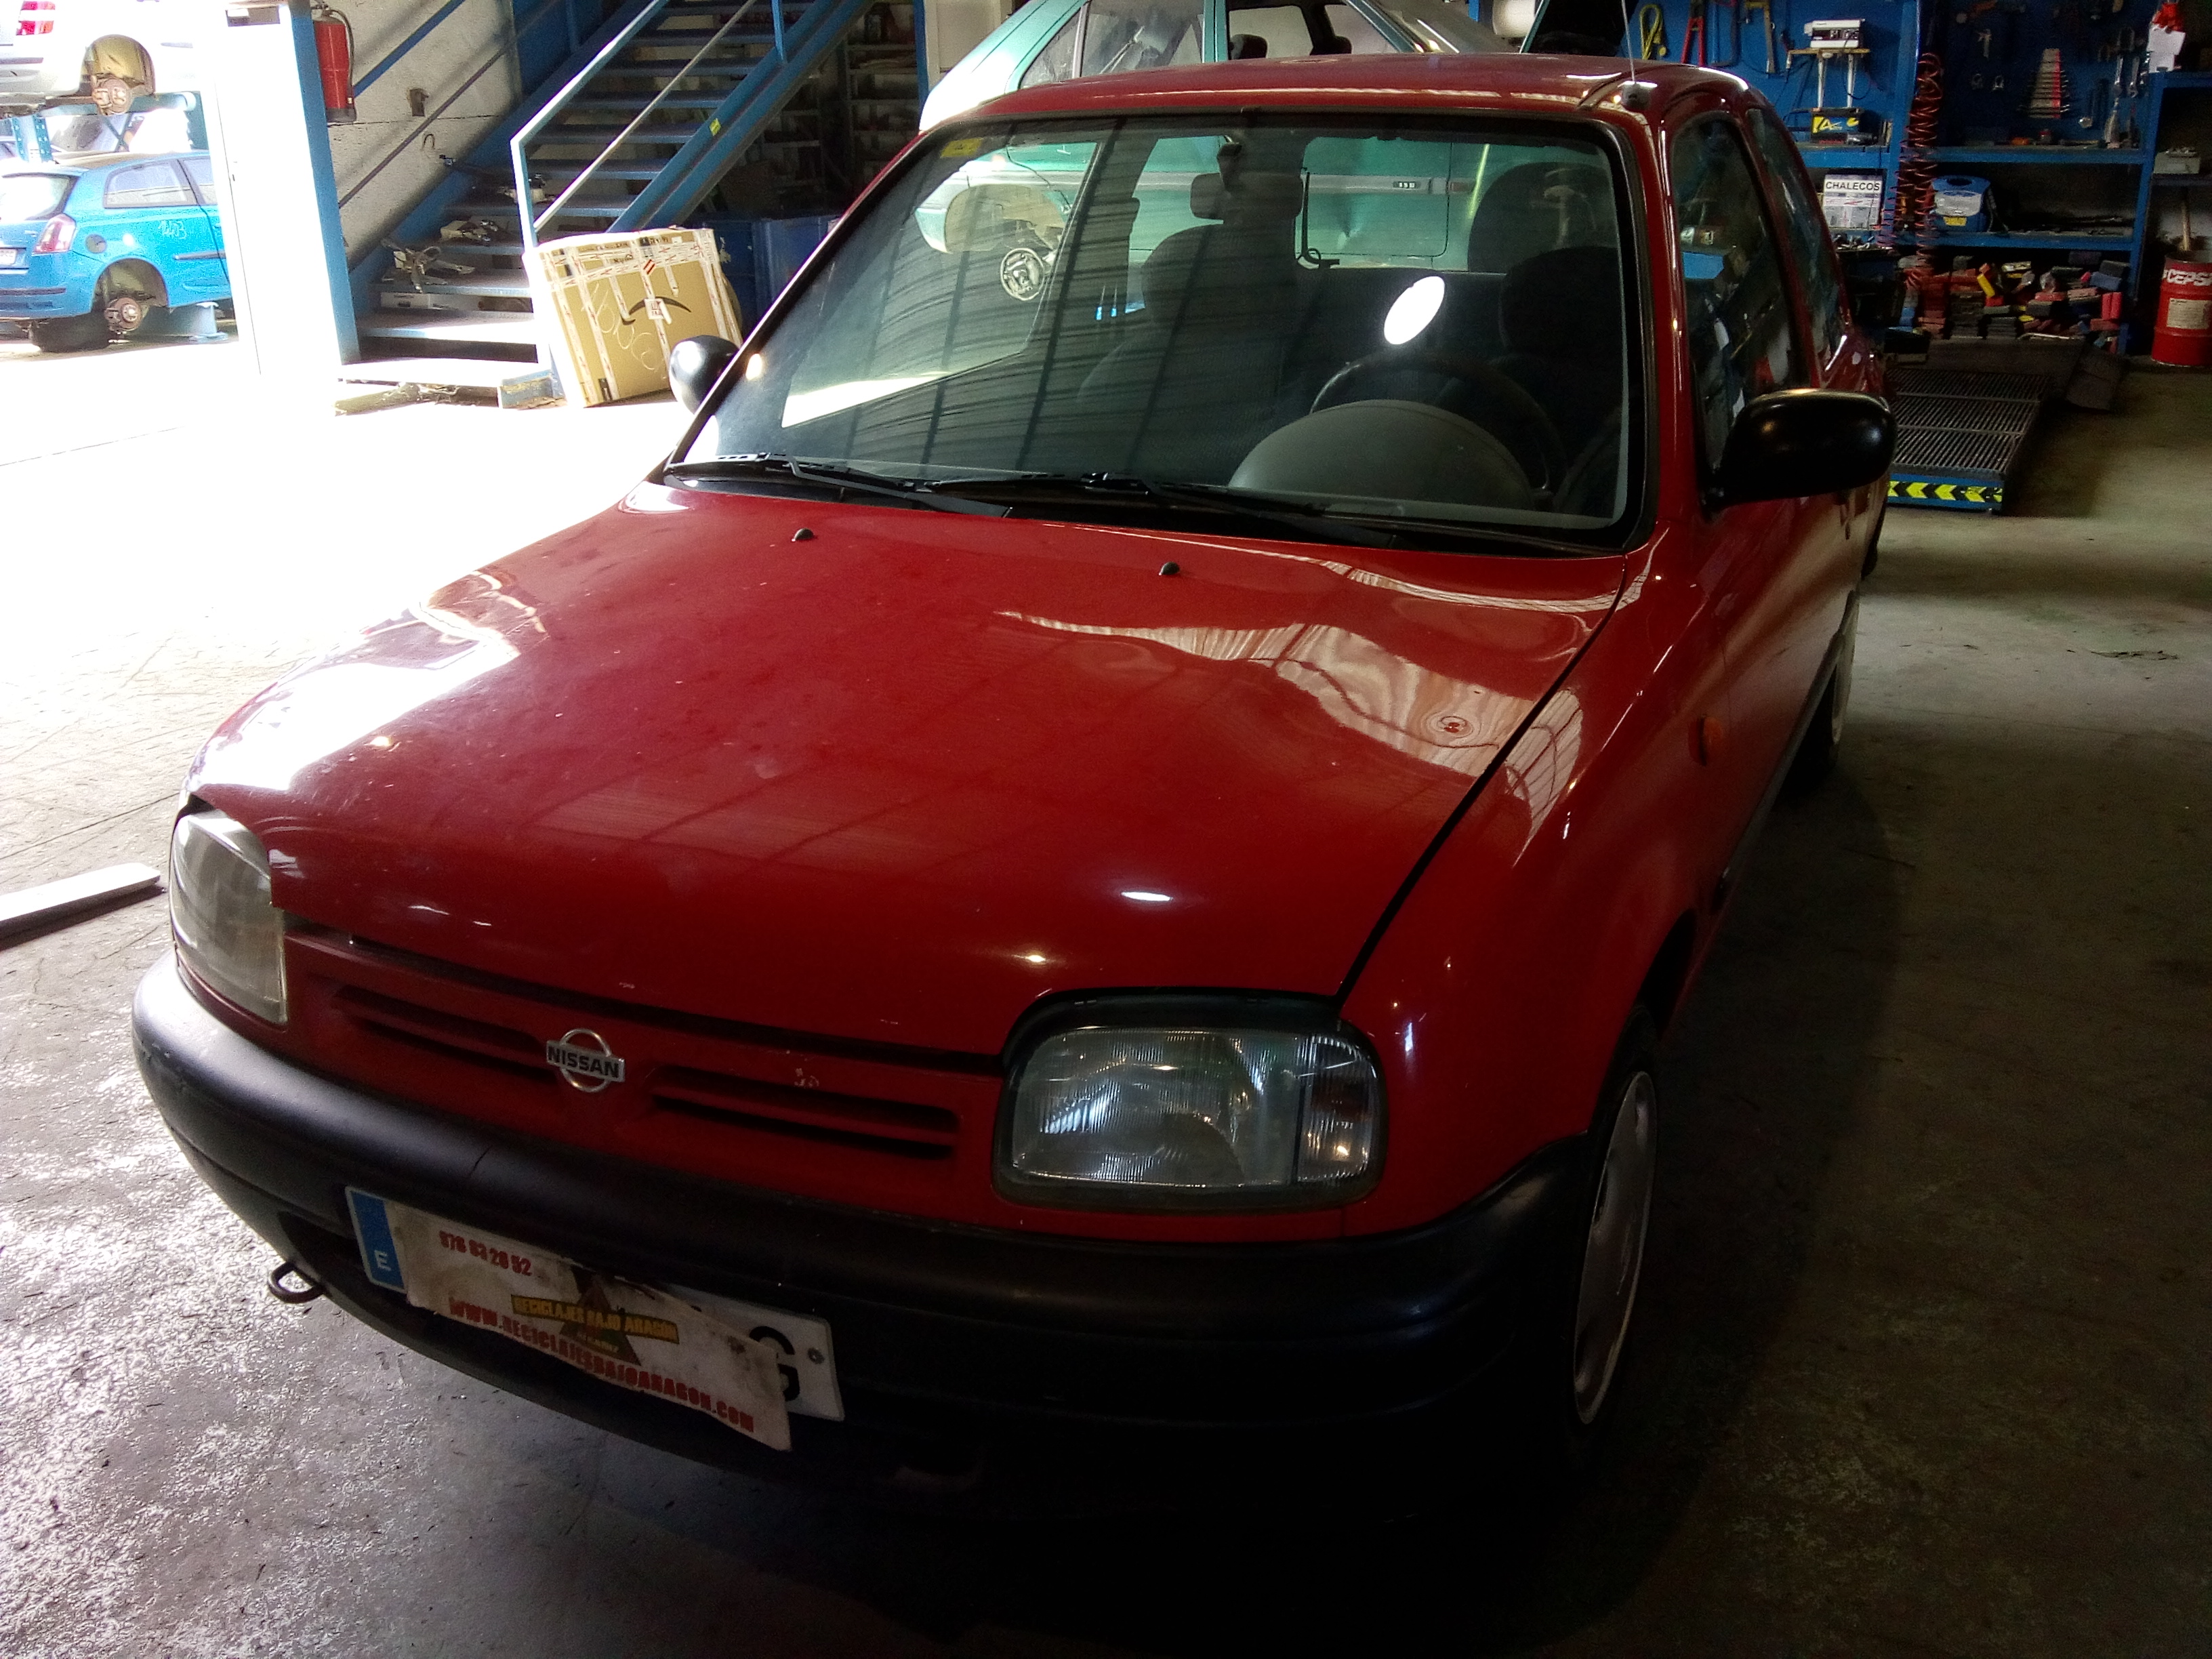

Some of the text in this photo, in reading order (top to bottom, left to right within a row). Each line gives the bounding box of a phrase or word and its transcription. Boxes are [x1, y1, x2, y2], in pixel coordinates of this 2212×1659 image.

[1826, 182, 1880, 190] CHALECOS
[2167, 269, 2212, 286] CEPS
[548, 1046, 619, 1078] NISSAN
[374, 1250, 392, 1272] E
